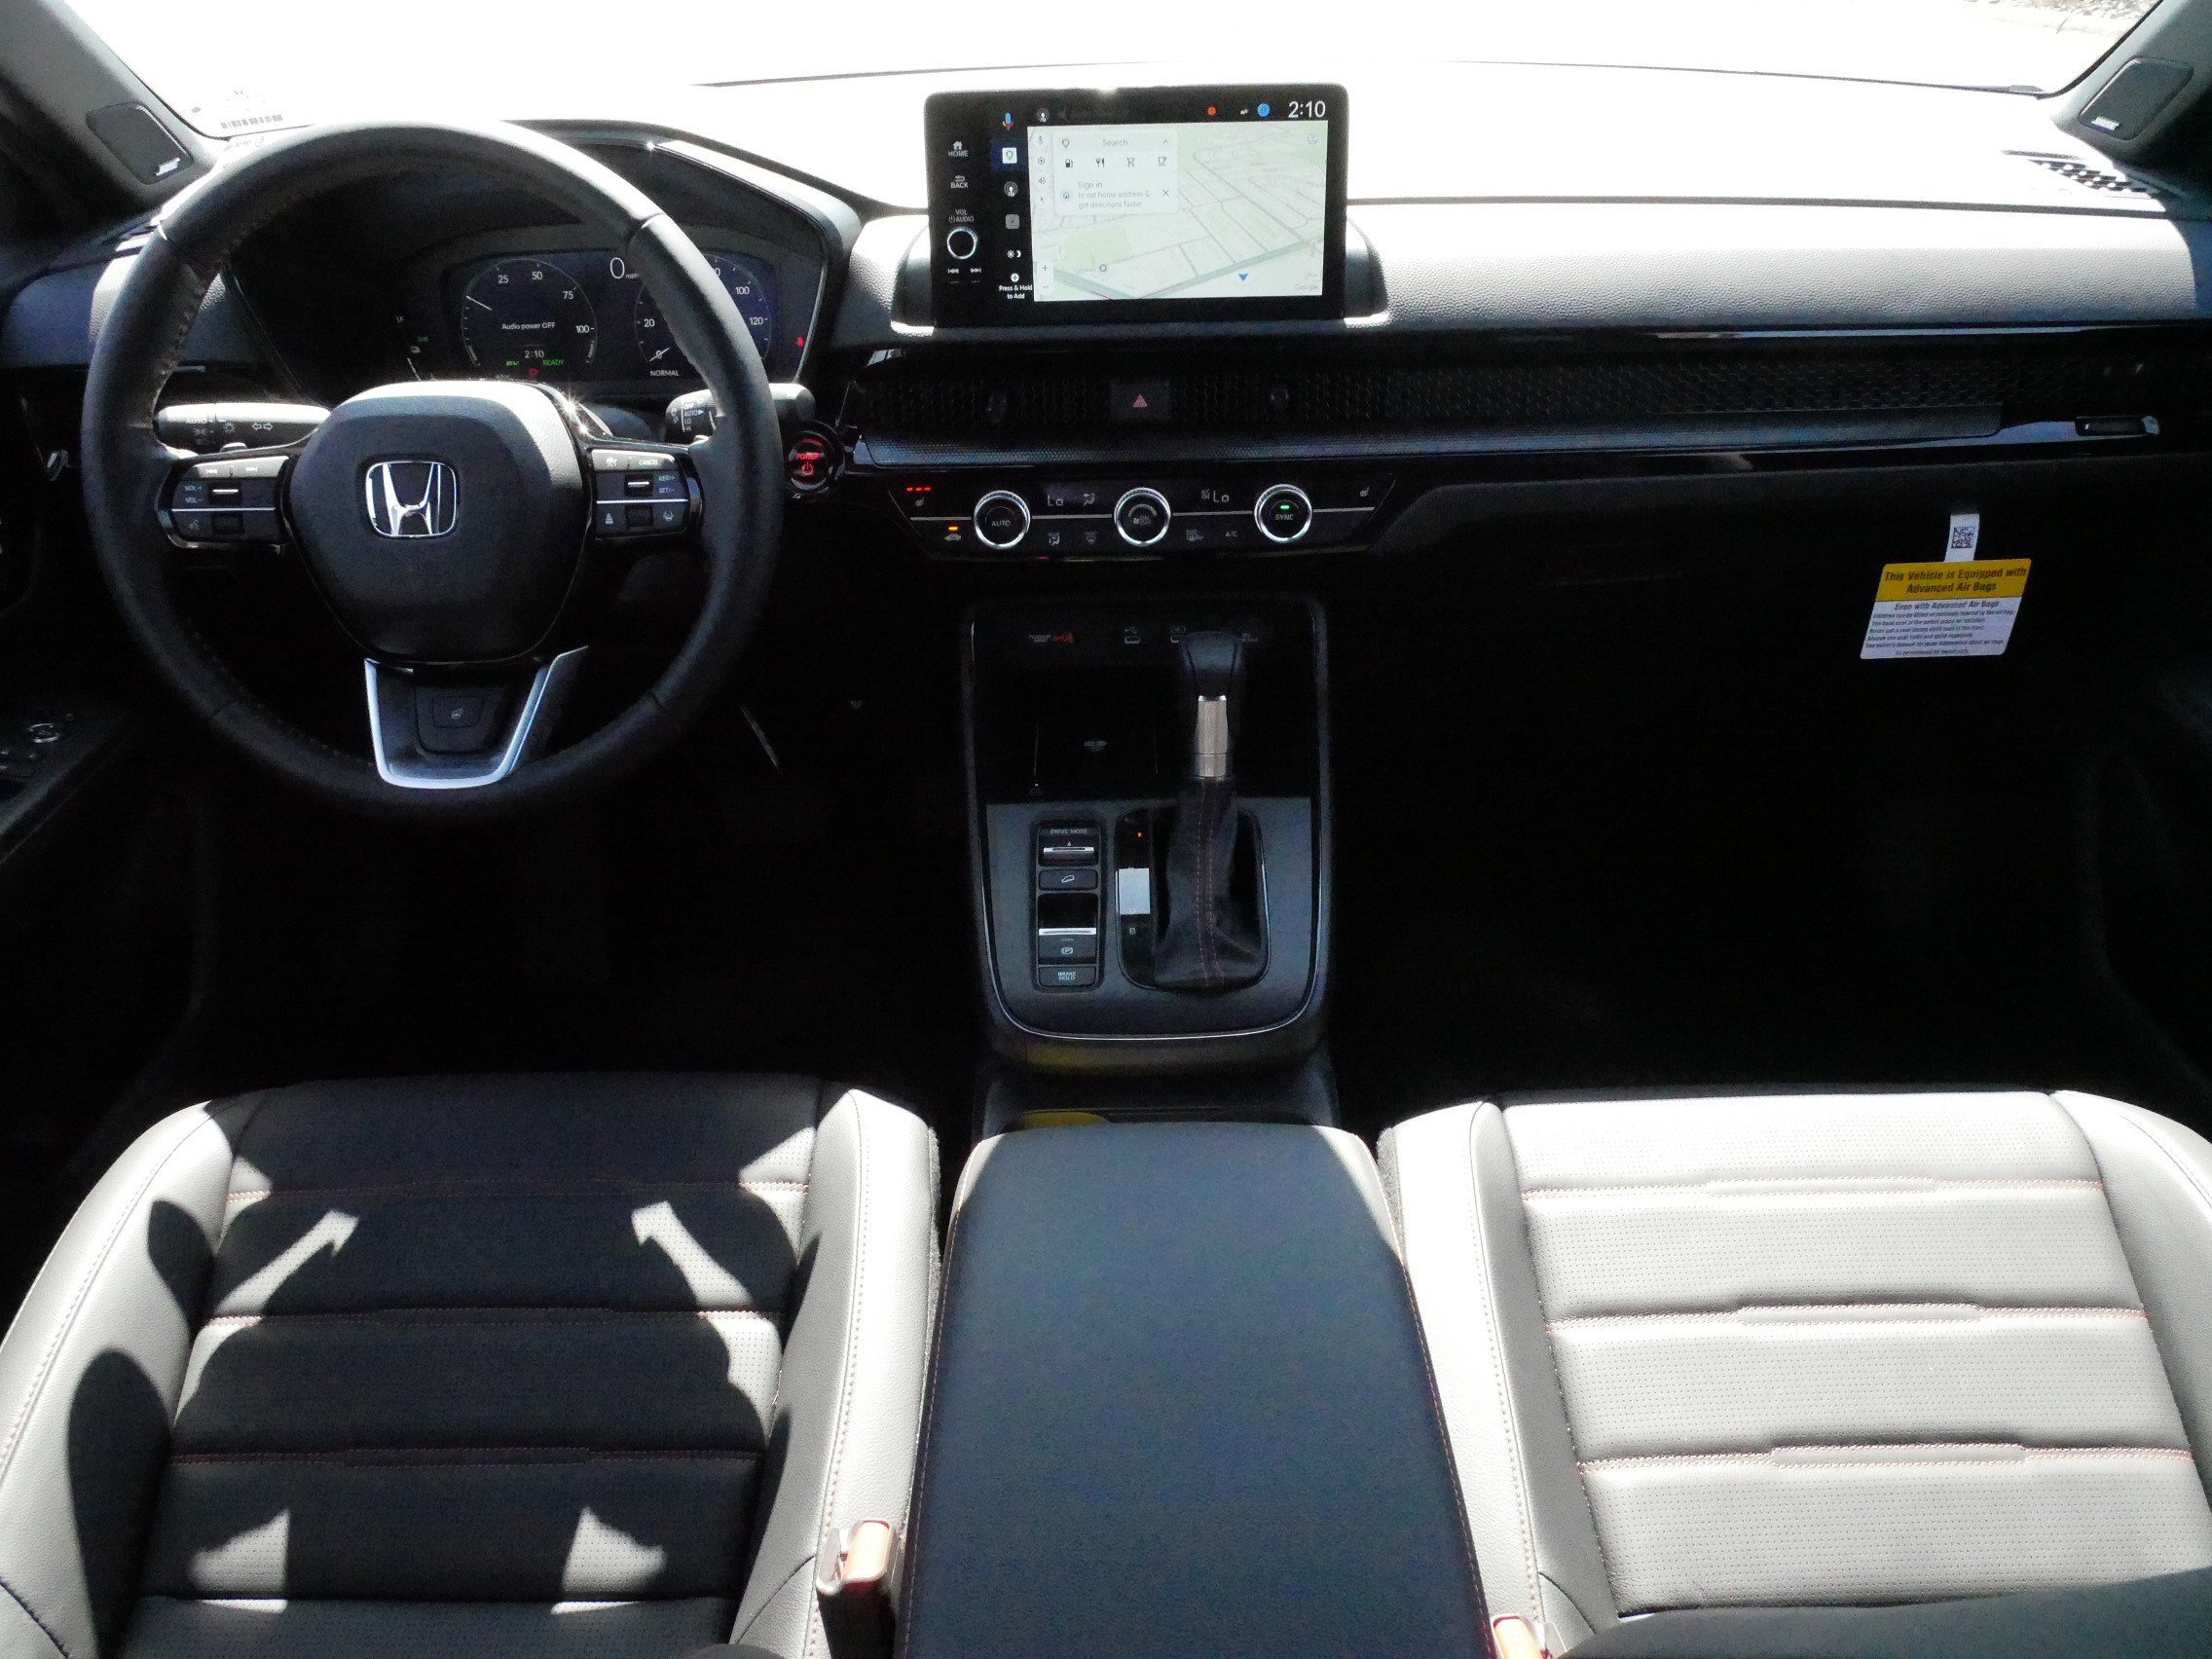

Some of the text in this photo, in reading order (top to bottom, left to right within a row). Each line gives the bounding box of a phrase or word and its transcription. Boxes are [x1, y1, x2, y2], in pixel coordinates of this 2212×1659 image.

[1288, 100, 1326, 118] 2:10
[1102, 138, 1127, 147] Search
[1078, 180, 1094, 190] Sign
[609, 257, 625, 280] 0
[498, 275, 509, 284] 25
[532, 271, 543, 280] 50
[563, 290, 574, 300] 75
[735, 286, 750, 295] 100
[644, 318, 655, 327] 20
[749, 316, 764, 325] 120
[521, 322, 540, 331] power
[575, 324, 590, 334] 100
[524, 350, 545, 359] 2:10
[542, 358, 565, 367] READY
[1047, 495, 1064, 506] Lo
[1213, 490, 1230, 502] Lo
[1884, 567, 2027, 582] This Vehicle is Equipped with
[1906, 581, 1997, 594] Advanced Air Bags
[1980, 600, 2000, 608] Bags
